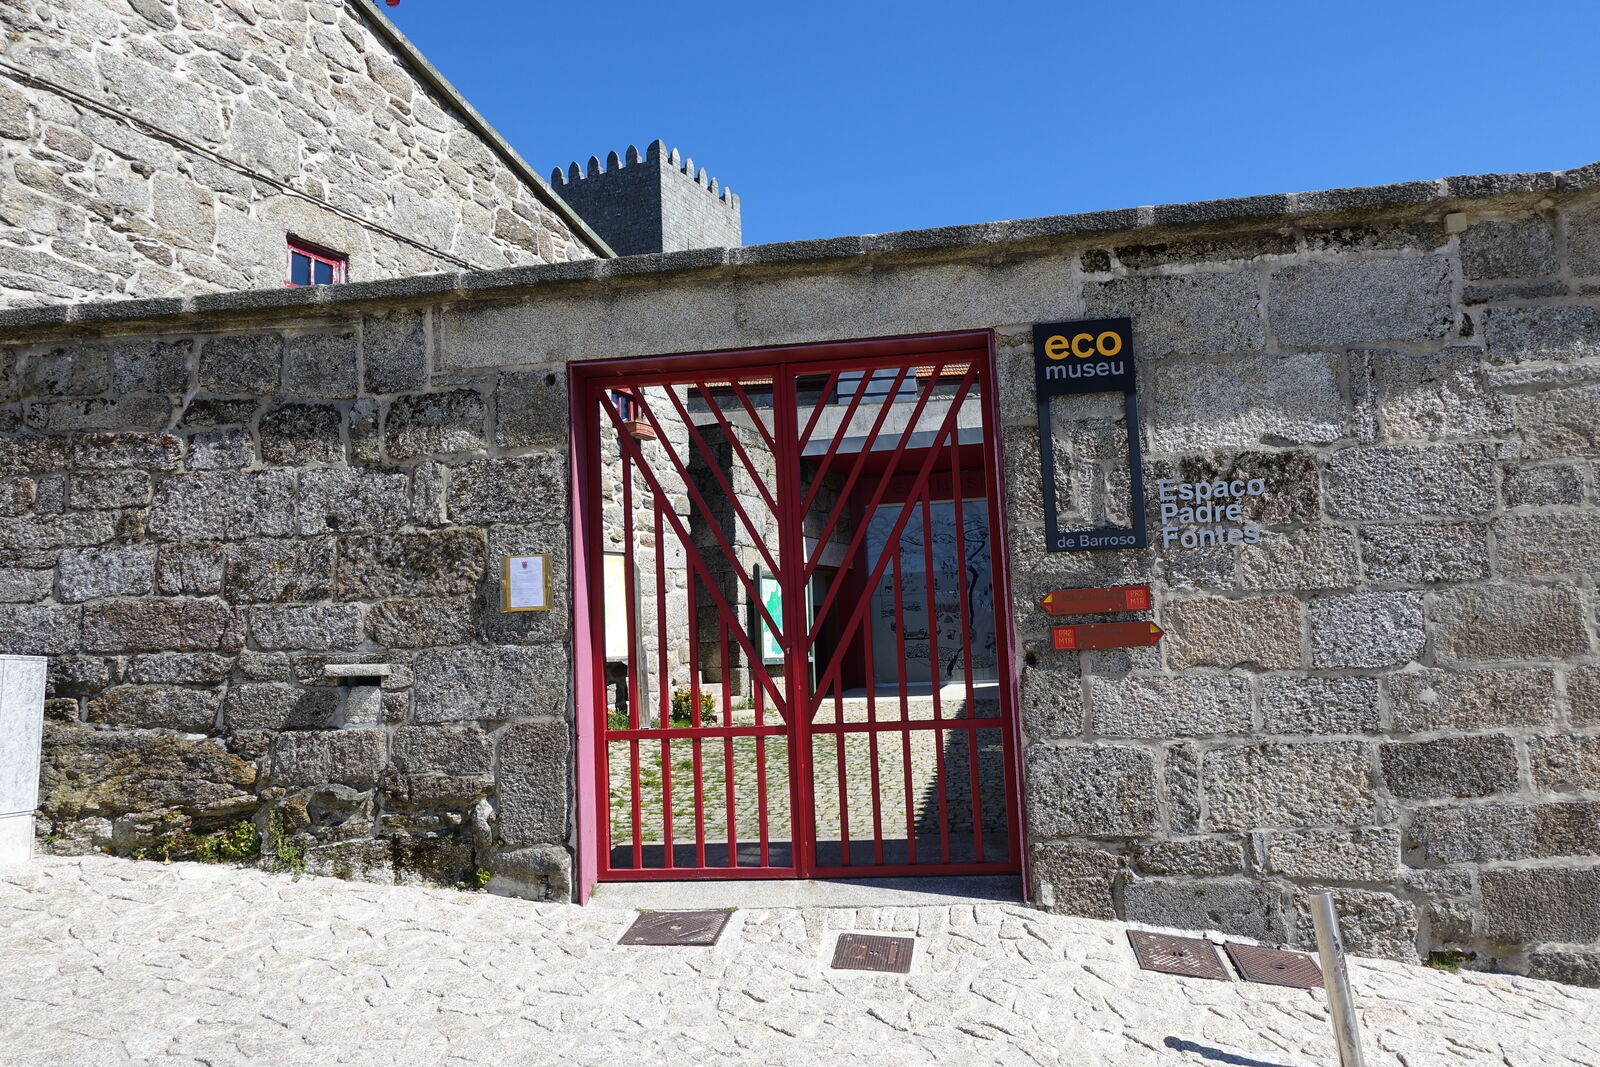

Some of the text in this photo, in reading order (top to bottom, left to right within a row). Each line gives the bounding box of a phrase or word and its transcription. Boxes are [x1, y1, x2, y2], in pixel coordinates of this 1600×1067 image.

[1044, 331, 1122, 360] eco
[1045, 361, 1125, 380] museu
[1158, 478, 1265, 505] Espaço
[1160, 501, 1242, 525] Padre
[1057, 534, 1136, 549] de Barroso
[1162, 525, 1260, 549] Fontes
